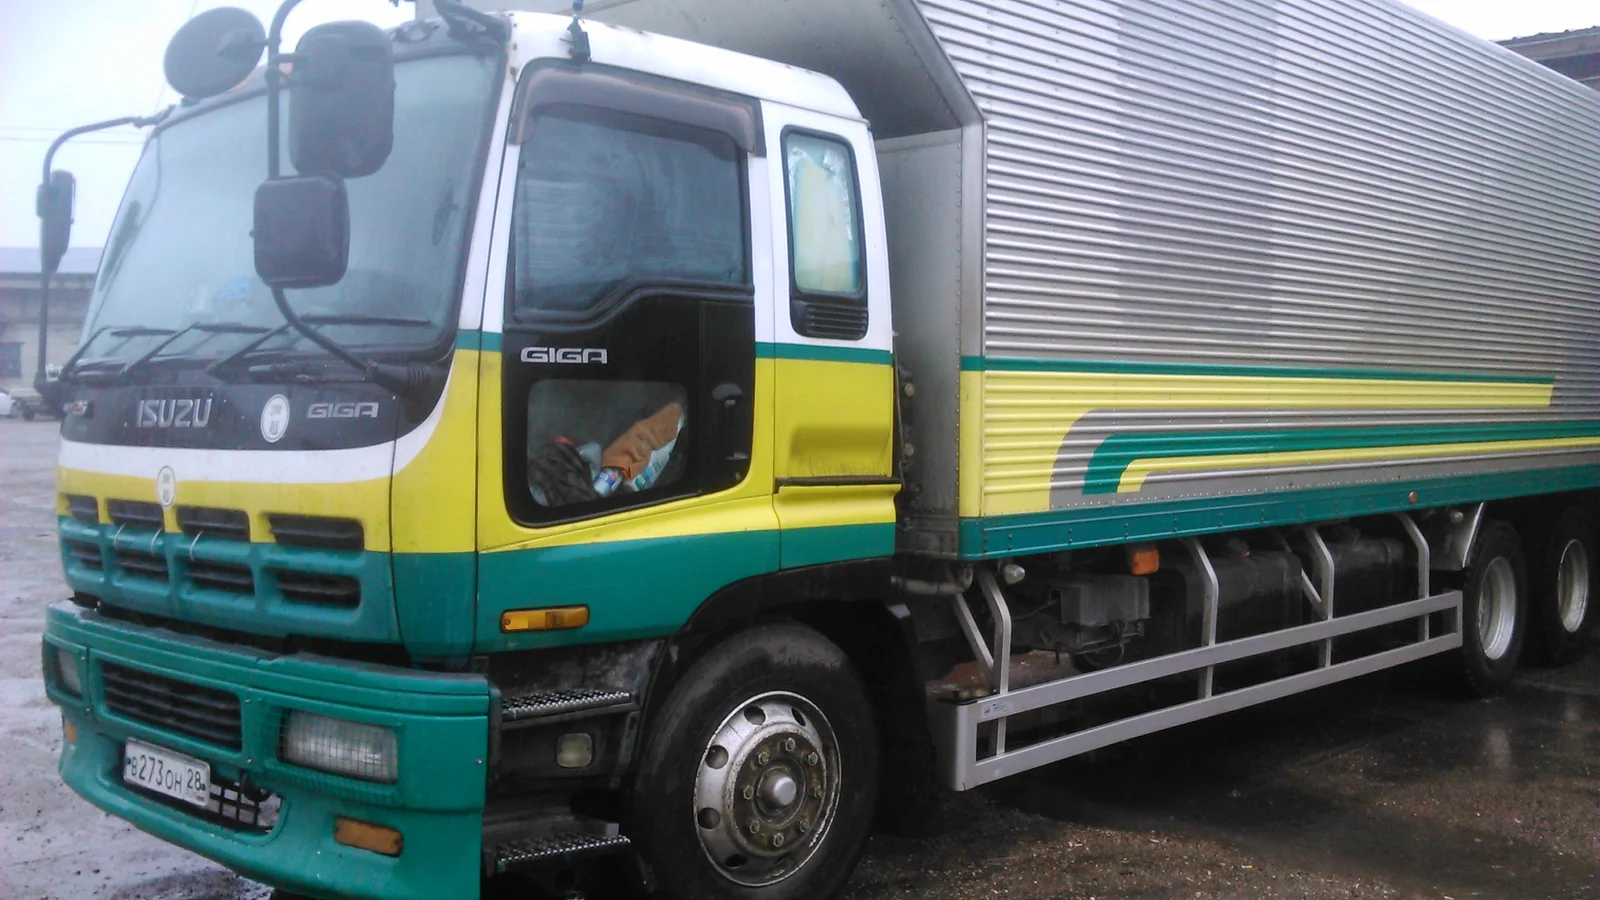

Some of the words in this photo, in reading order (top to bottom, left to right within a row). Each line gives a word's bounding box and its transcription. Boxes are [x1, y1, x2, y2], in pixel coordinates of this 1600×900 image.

[520, 346, 608, 364] GIGA
[136, 398, 212, 428] ISUZU
[307, 402, 379, 418] GIGA
[187, 768, 202, 791] 28
